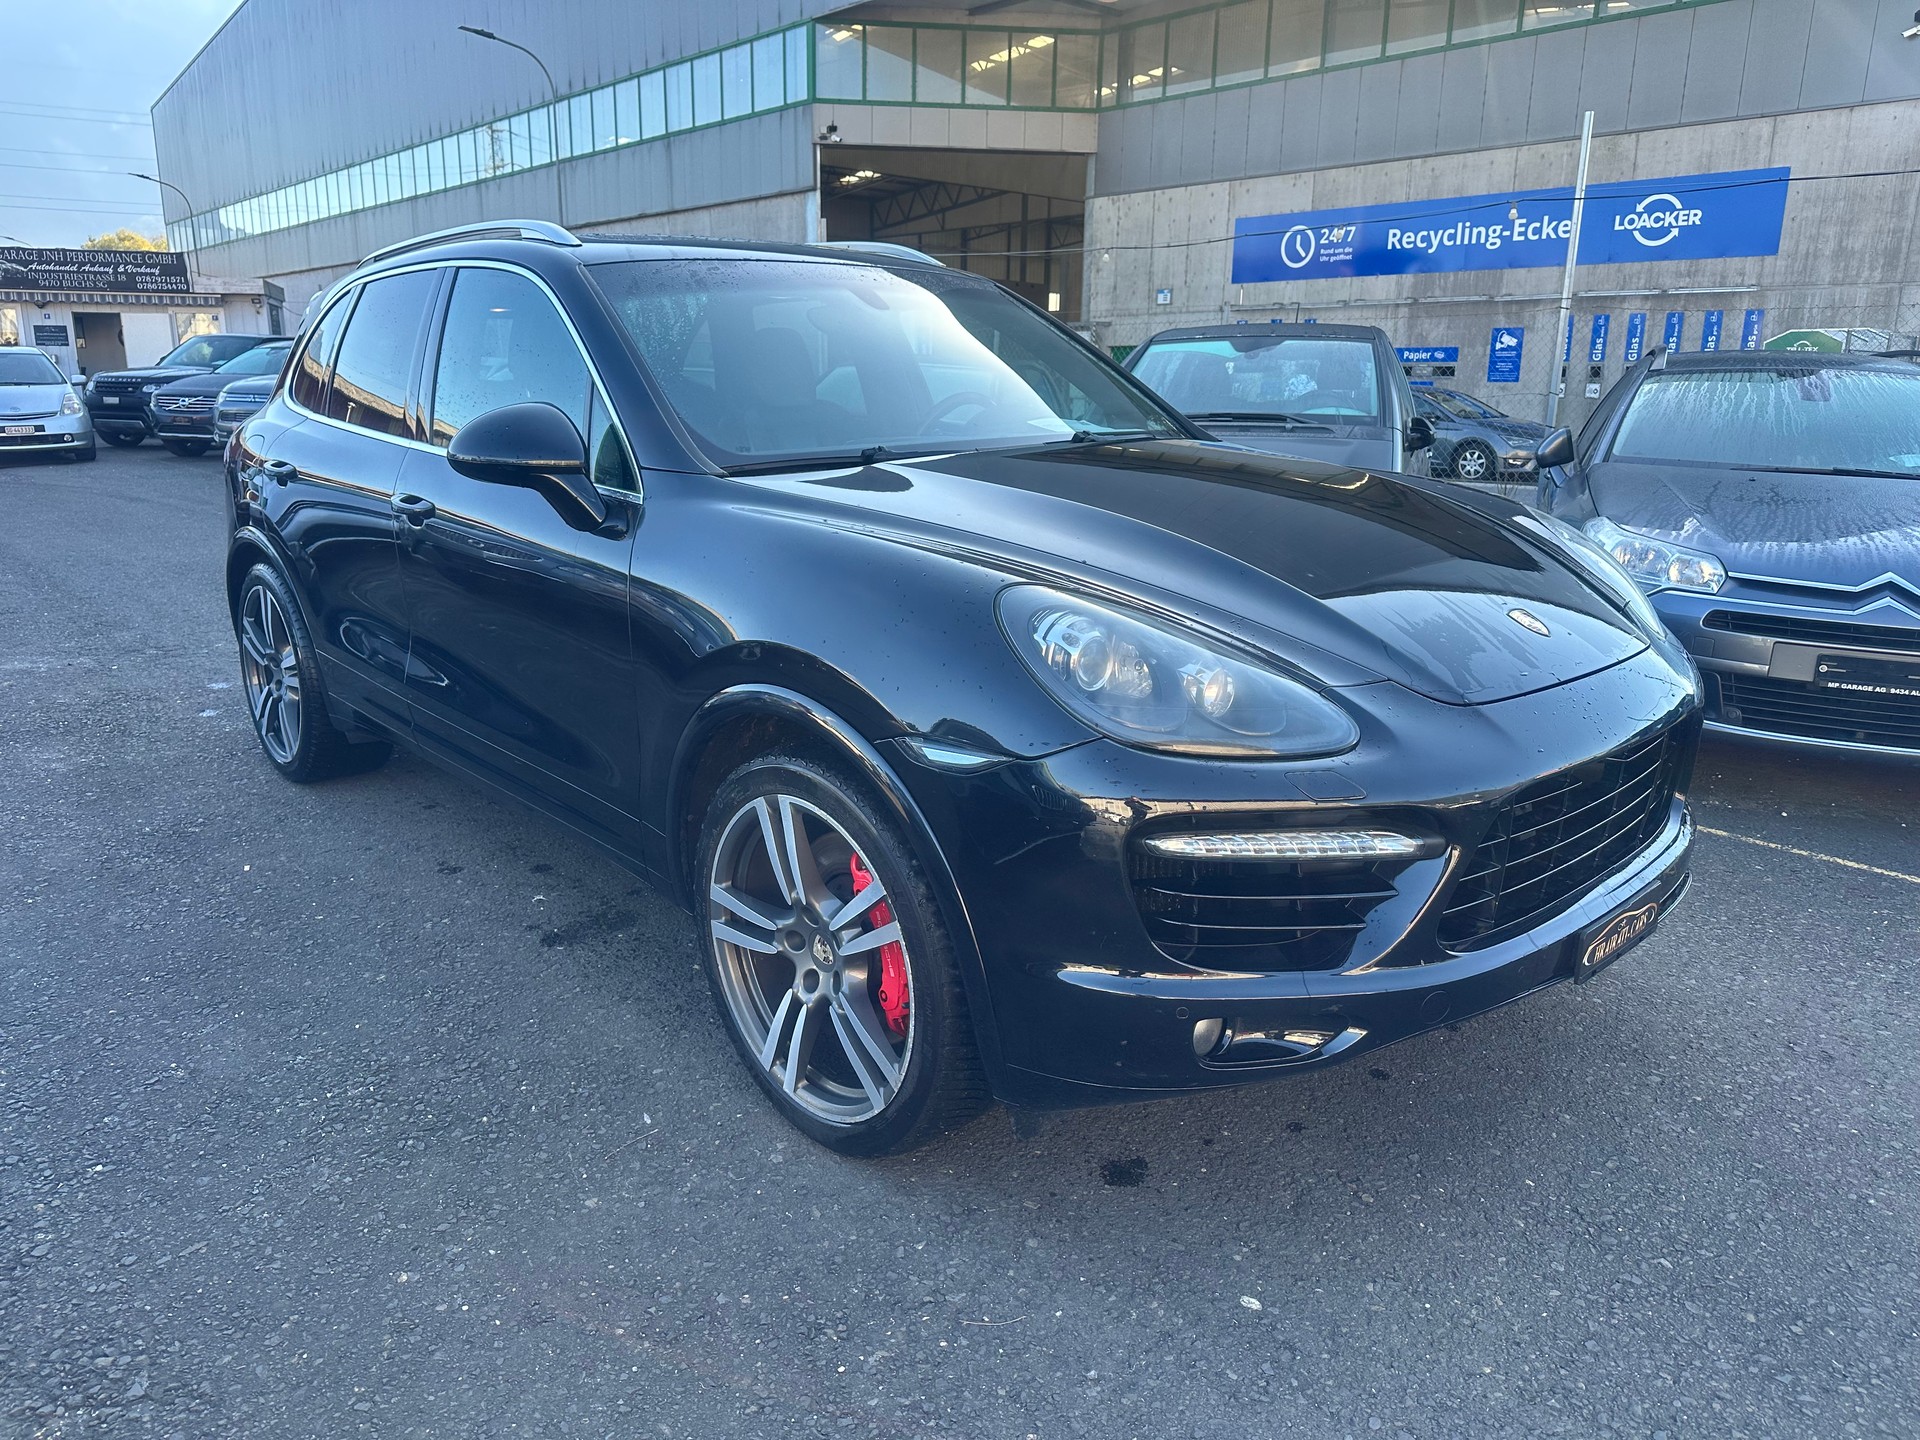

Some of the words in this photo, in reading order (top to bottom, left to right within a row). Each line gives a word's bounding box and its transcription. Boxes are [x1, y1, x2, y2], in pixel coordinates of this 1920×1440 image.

[1614, 210, 1702, 231] LOACKER
[1319, 226, 1356, 244] 24/7
[1387, 215, 1571, 253] Recycling-Ecke
[41, 250, 63, 261] JNH
[66, 251, 143, 263] PERFORMANCE
[145, 253, 177, 264] GMBH
[1330, 254, 1353, 262] geöffnet
[27, 261, 79, 271] Autohandel
[79, 262, 114, 274] Ankauf
[125, 264, 161, 275] Verkauf
[28, 272, 116, 282] INDUSTRIESTRASSE
[1592, 337, 1604, 361] Glas
[1628, 337, 1639, 361] Glas
[1667, 337, 1677, 354] las
[1704, 335, 1716, 351] las
[1744, 335, 1756, 350] las
[1403, 351, 1431, 361] Papier
[1841, 683, 1874, 692] GARAGE
